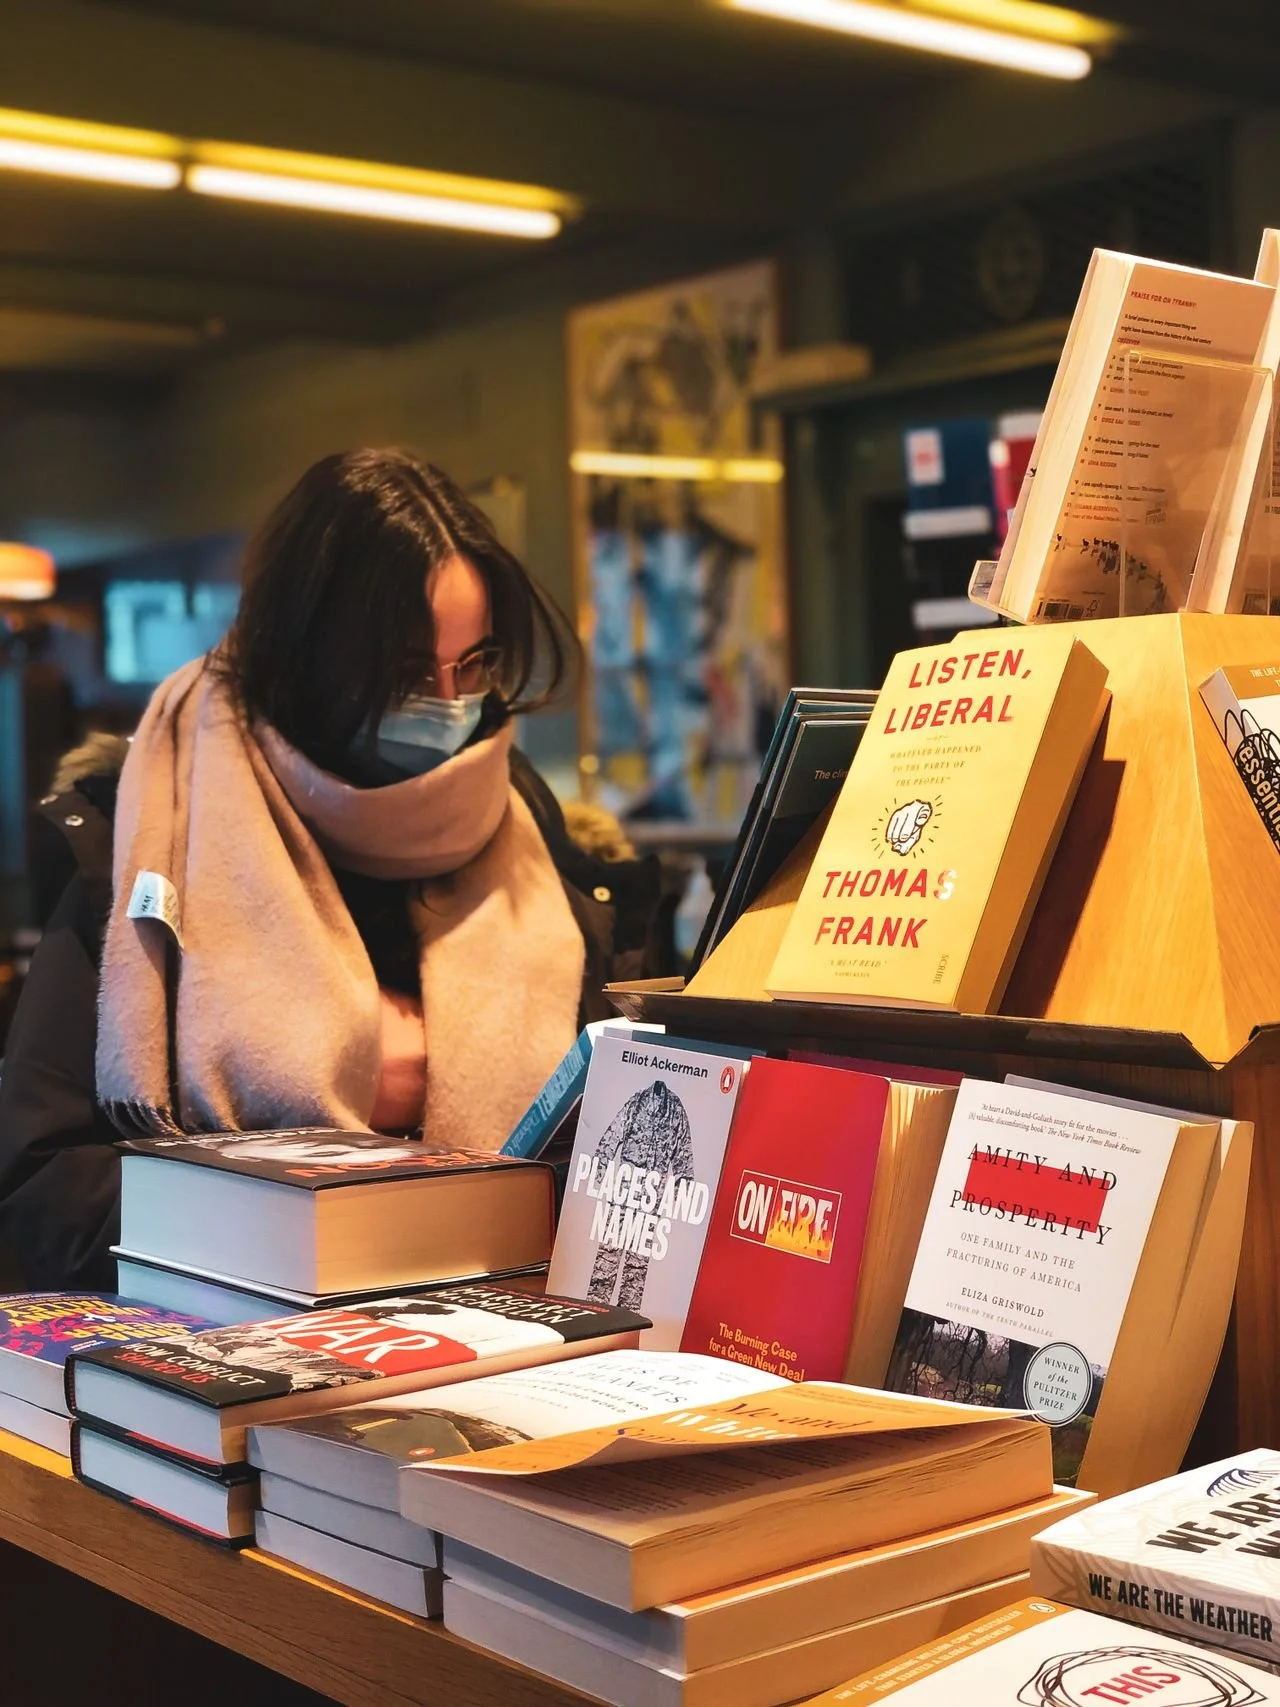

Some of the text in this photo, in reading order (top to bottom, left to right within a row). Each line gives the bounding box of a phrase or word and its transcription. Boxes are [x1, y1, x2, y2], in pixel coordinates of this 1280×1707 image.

[908, 648, 1032, 689] LISTEN,
[883, 695, 1014, 735] LIBERAL
[815, 769, 830, 780] The
[822, 868, 958, 900] THOMAS
[814, 916, 928, 948] FRANK
[932, 954, 949, 985] SCRIBE
[622, 1050, 708, 1078] Elliot Ackerman
[988, 1104, 1000, 1113] heart
[1053, 1117, 1067, 1128] story
[1076, 1120, 1085, 1130] for
[1086, 1123, 1095, 1132] the
[1048, 1127, 1057, 1136] The
[1058, 1130, 1071, 1139] New
[1072, 1132, 1085, 1142] York
[1086, 1135, 1102, 1146] Times
[968, 1143, 1118, 1192] AMITY AND
[573, 1153, 710, 1226] PLACES AND
[737, 1181, 832, 1240] ON FIRE
[949, 1189, 1113, 1246] PROSPERITY
[590, 1200, 671, 1261] NAMES
[960, 1232, 1075, 1270] ONE FAMILY AND THE
[946, 1248, 1082, 1292] FRACTURING OF AMERICA
[425, 1291, 573, 1324] MACMILLAN
[452, 1287, 596, 1317] MARGARET
[946, 1301, 970, 1314] AUTHOR
[972, 1307, 980, 1315] OF
[982, 1311, 995, 1320] THE
[996, 1315, 1018, 1327] TENTH
[961, 1287, 1044, 1318] ELIZA GRISWOLD
[257, 1312, 440, 1363] WAR
[719, 1322, 797, 1362] The Burning Case
[114, 1352, 217, 1384] SHAPED US
[121, 1342, 174, 1357] HOW
[166, 1355, 266, 1386] CONFLICT
[709, 1337, 805, 1382] for a Green New Deal
[1044, 1357, 1080, 1374] WINNER
[583, 1372, 688, 1405] PLANETS
[658, 1374, 698, 1387] OF
[1033, 1381, 1077, 1401] PULITZER
[1048, 1373, 1069, 1384] of the
[1040, 1396, 1065, 1411] PRIZE
[662, 1412, 799, 1439] White
[779, 1411, 874, 1431] and
[1145, 1521, 1241, 1554] WE
[1088, 1573, 1273, 1643] WE ARE THE WEATHER
[1080, 1665, 1181, 1705] THIS
